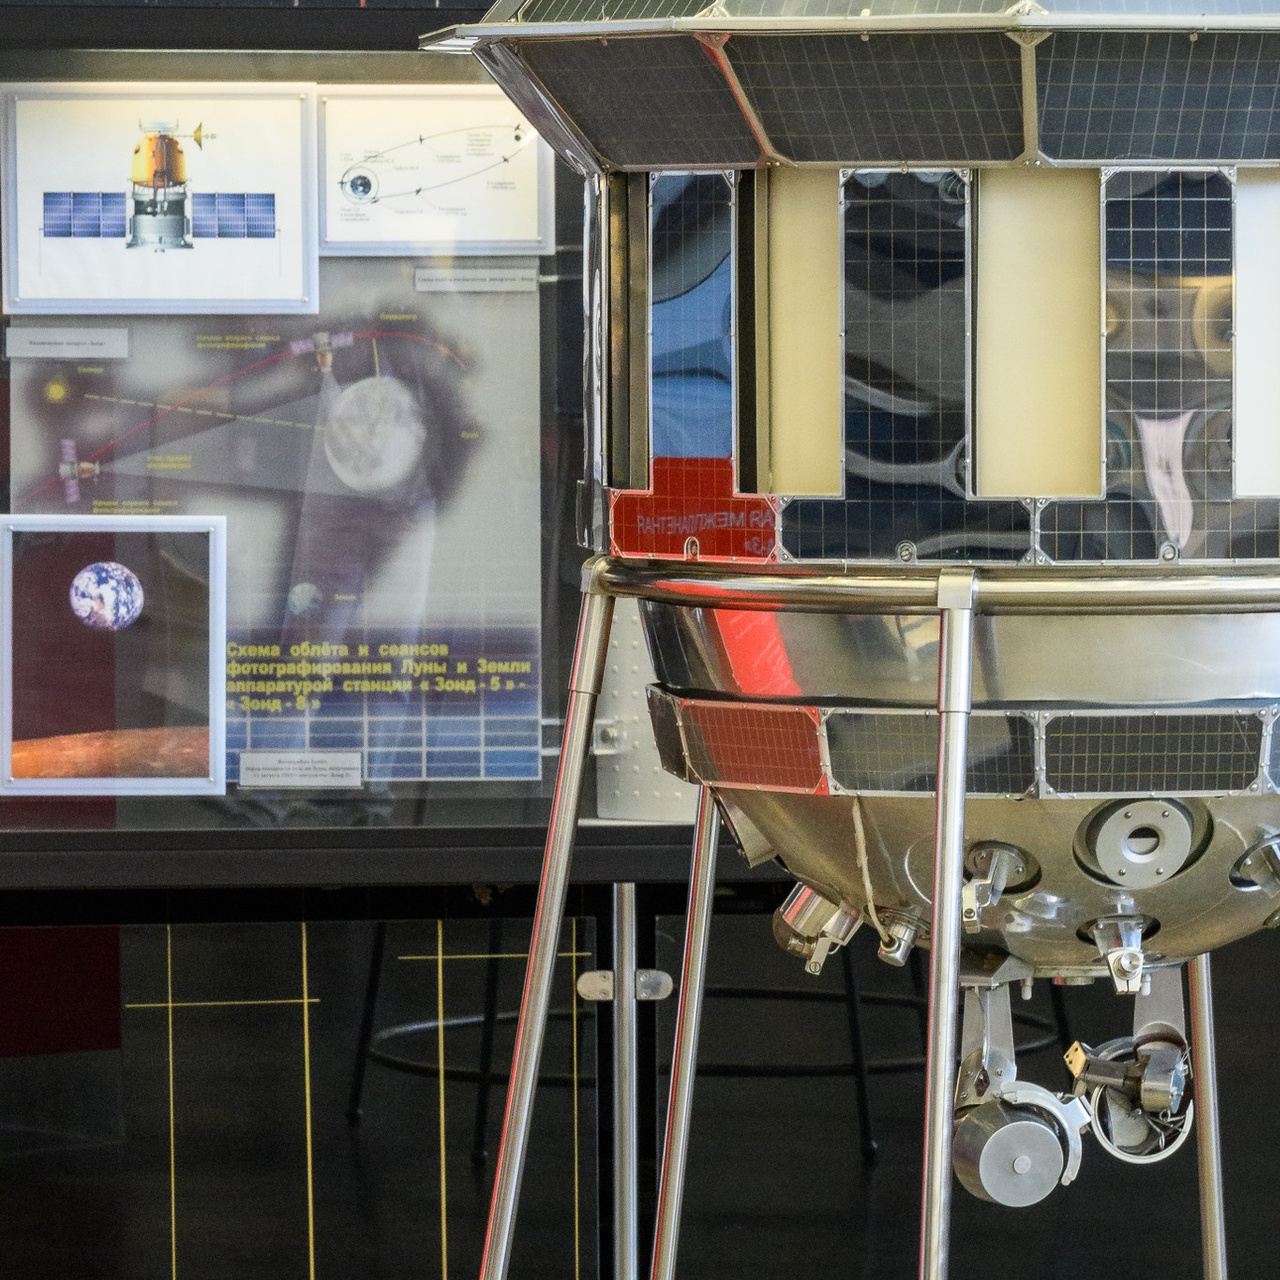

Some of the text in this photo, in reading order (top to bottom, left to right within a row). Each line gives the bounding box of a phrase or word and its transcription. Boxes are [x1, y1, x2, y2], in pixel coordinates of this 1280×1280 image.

[227, 641, 448, 657] Схема облёта и сеансов
[226, 658, 531, 678] фотографирования Луны и Земли
[226, 677, 333, 696] аппаратурой
[343, 680, 412, 693] станции
[434, 676, 477, 693] Зонд
[240, 695, 281, 712] Зонд
